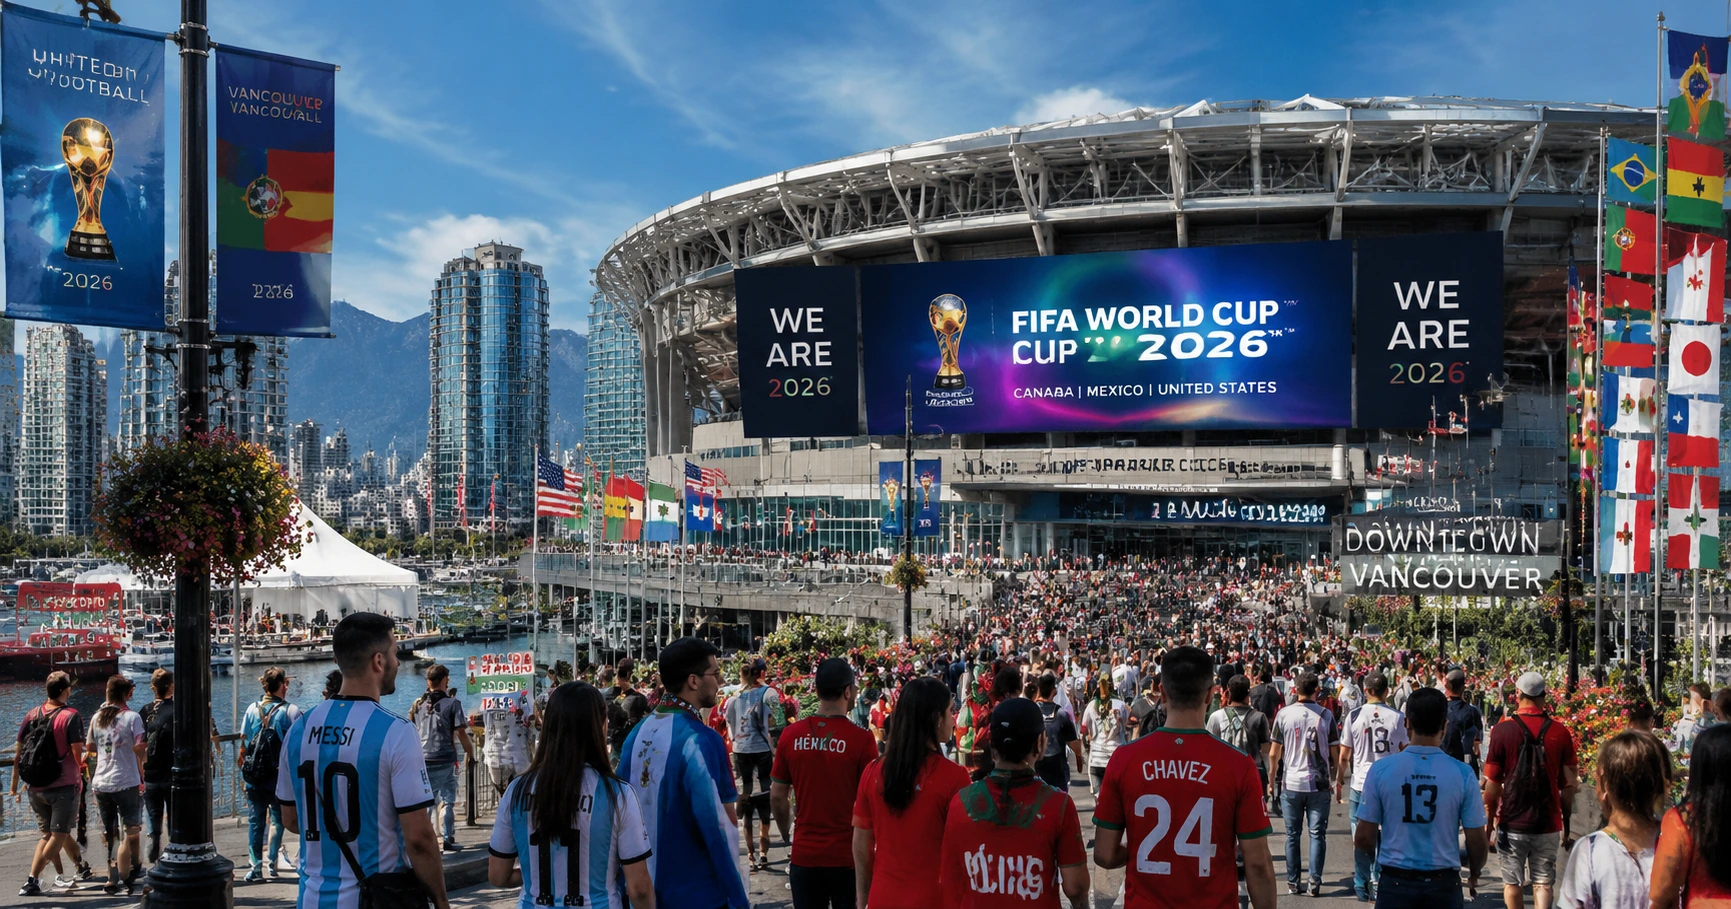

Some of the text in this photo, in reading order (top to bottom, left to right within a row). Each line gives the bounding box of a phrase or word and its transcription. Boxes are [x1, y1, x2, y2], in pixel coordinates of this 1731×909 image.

[62, 271, 114, 291] 2026
[1393, 280, 1459, 310] WE
[769, 307, 824, 333] WE
[1012, 300, 1279, 333] FIFA WORLD CUP
[1012, 329, 1268, 364] CUP 2026
[1387, 319, 1470, 350] ARE
[765, 341, 832, 367] ARE
[1389, 361, 1466, 385] 2026
[769, 377, 832, 398] 2026
[1087, 384, 1144, 397] MEXICO
[1158, 383, 1214, 396] UNITED
[1219, 381, 1277, 394] STATES
[1349, 562, 1543, 595] VANCOUVER
[308, 725, 355, 746] MESSI
[1142, 759, 1212, 785] CHAVEZ
[297, 760, 361, 842] 10
[1401, 782, 1438, 824] 13
[1134, 794, 1217, 877] 24
